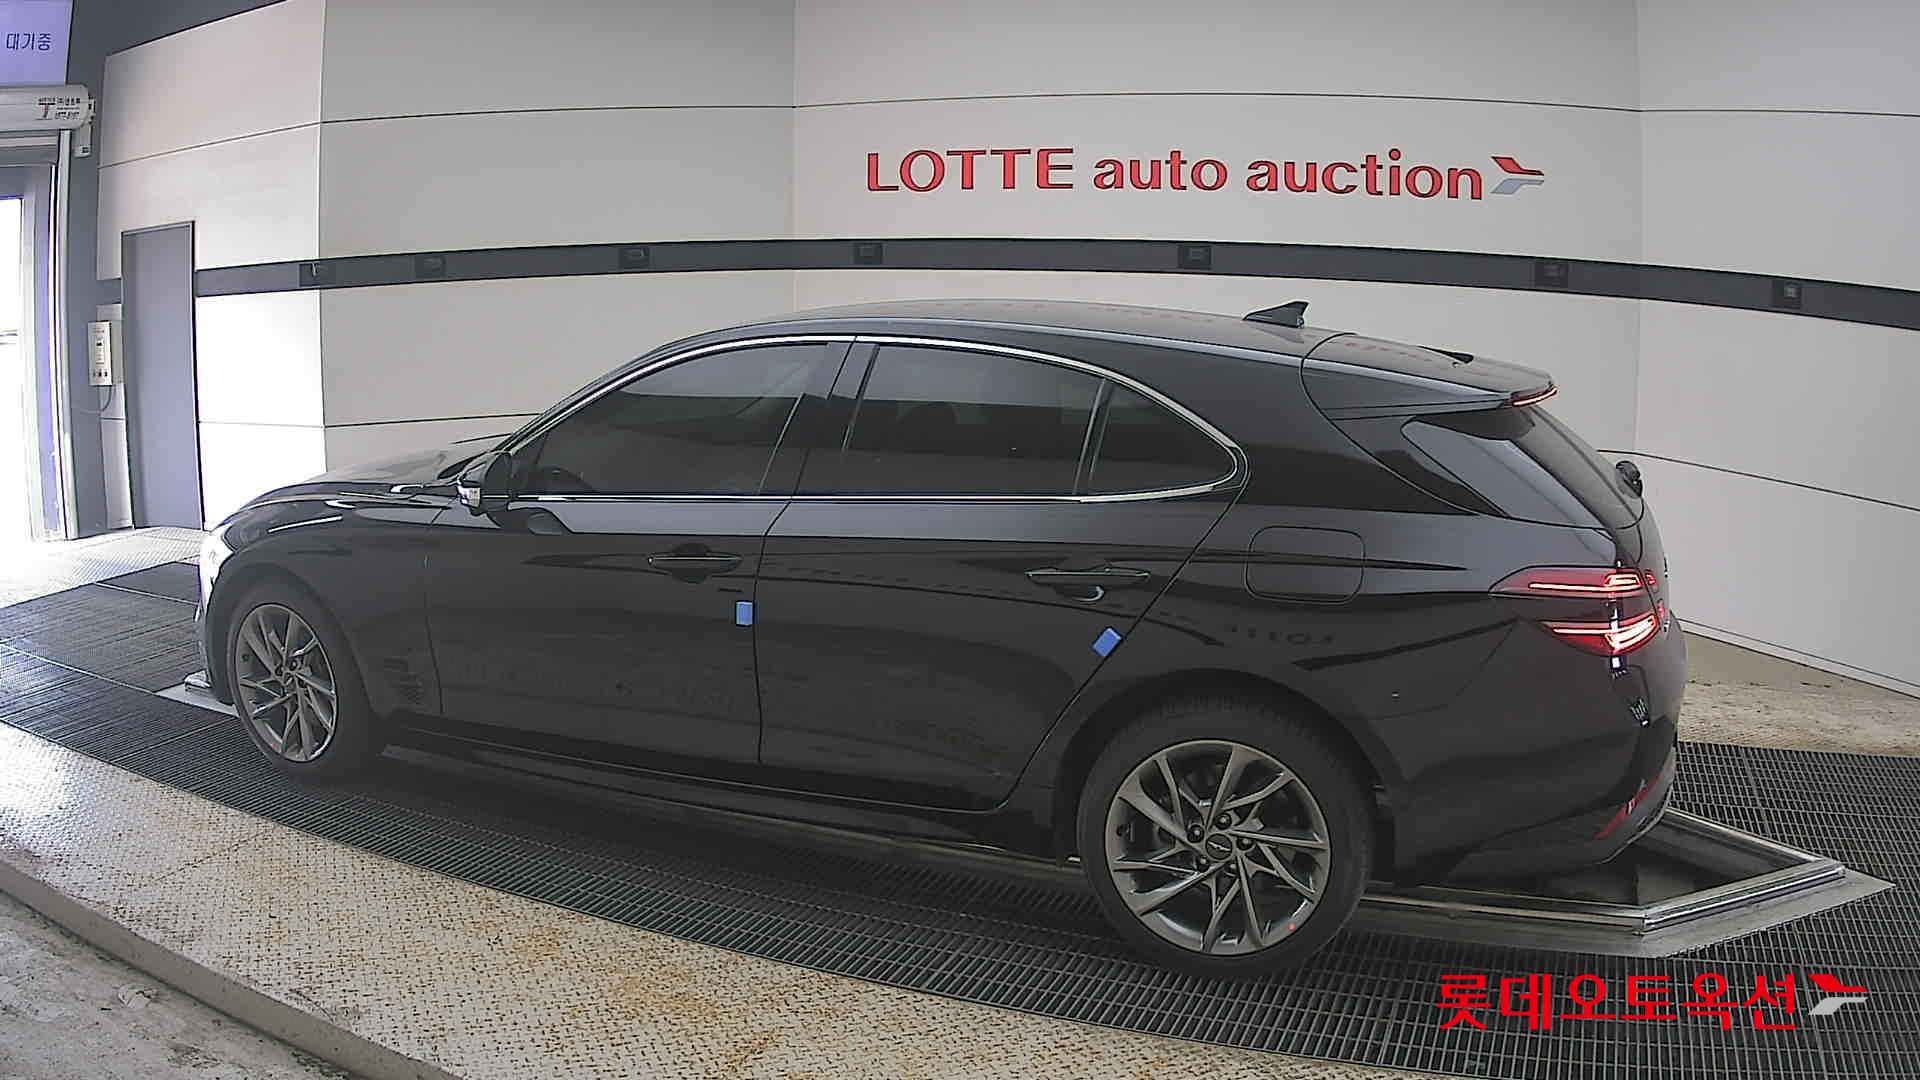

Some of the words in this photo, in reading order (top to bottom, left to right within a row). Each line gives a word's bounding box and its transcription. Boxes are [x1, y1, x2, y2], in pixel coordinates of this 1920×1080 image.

[6, 32, 52, 51] 대기중
[867, 148, 1073, 192] LOTTE
[1093, 150, 1227, 191] auto
[1246, 148, 1482, 200] auction
